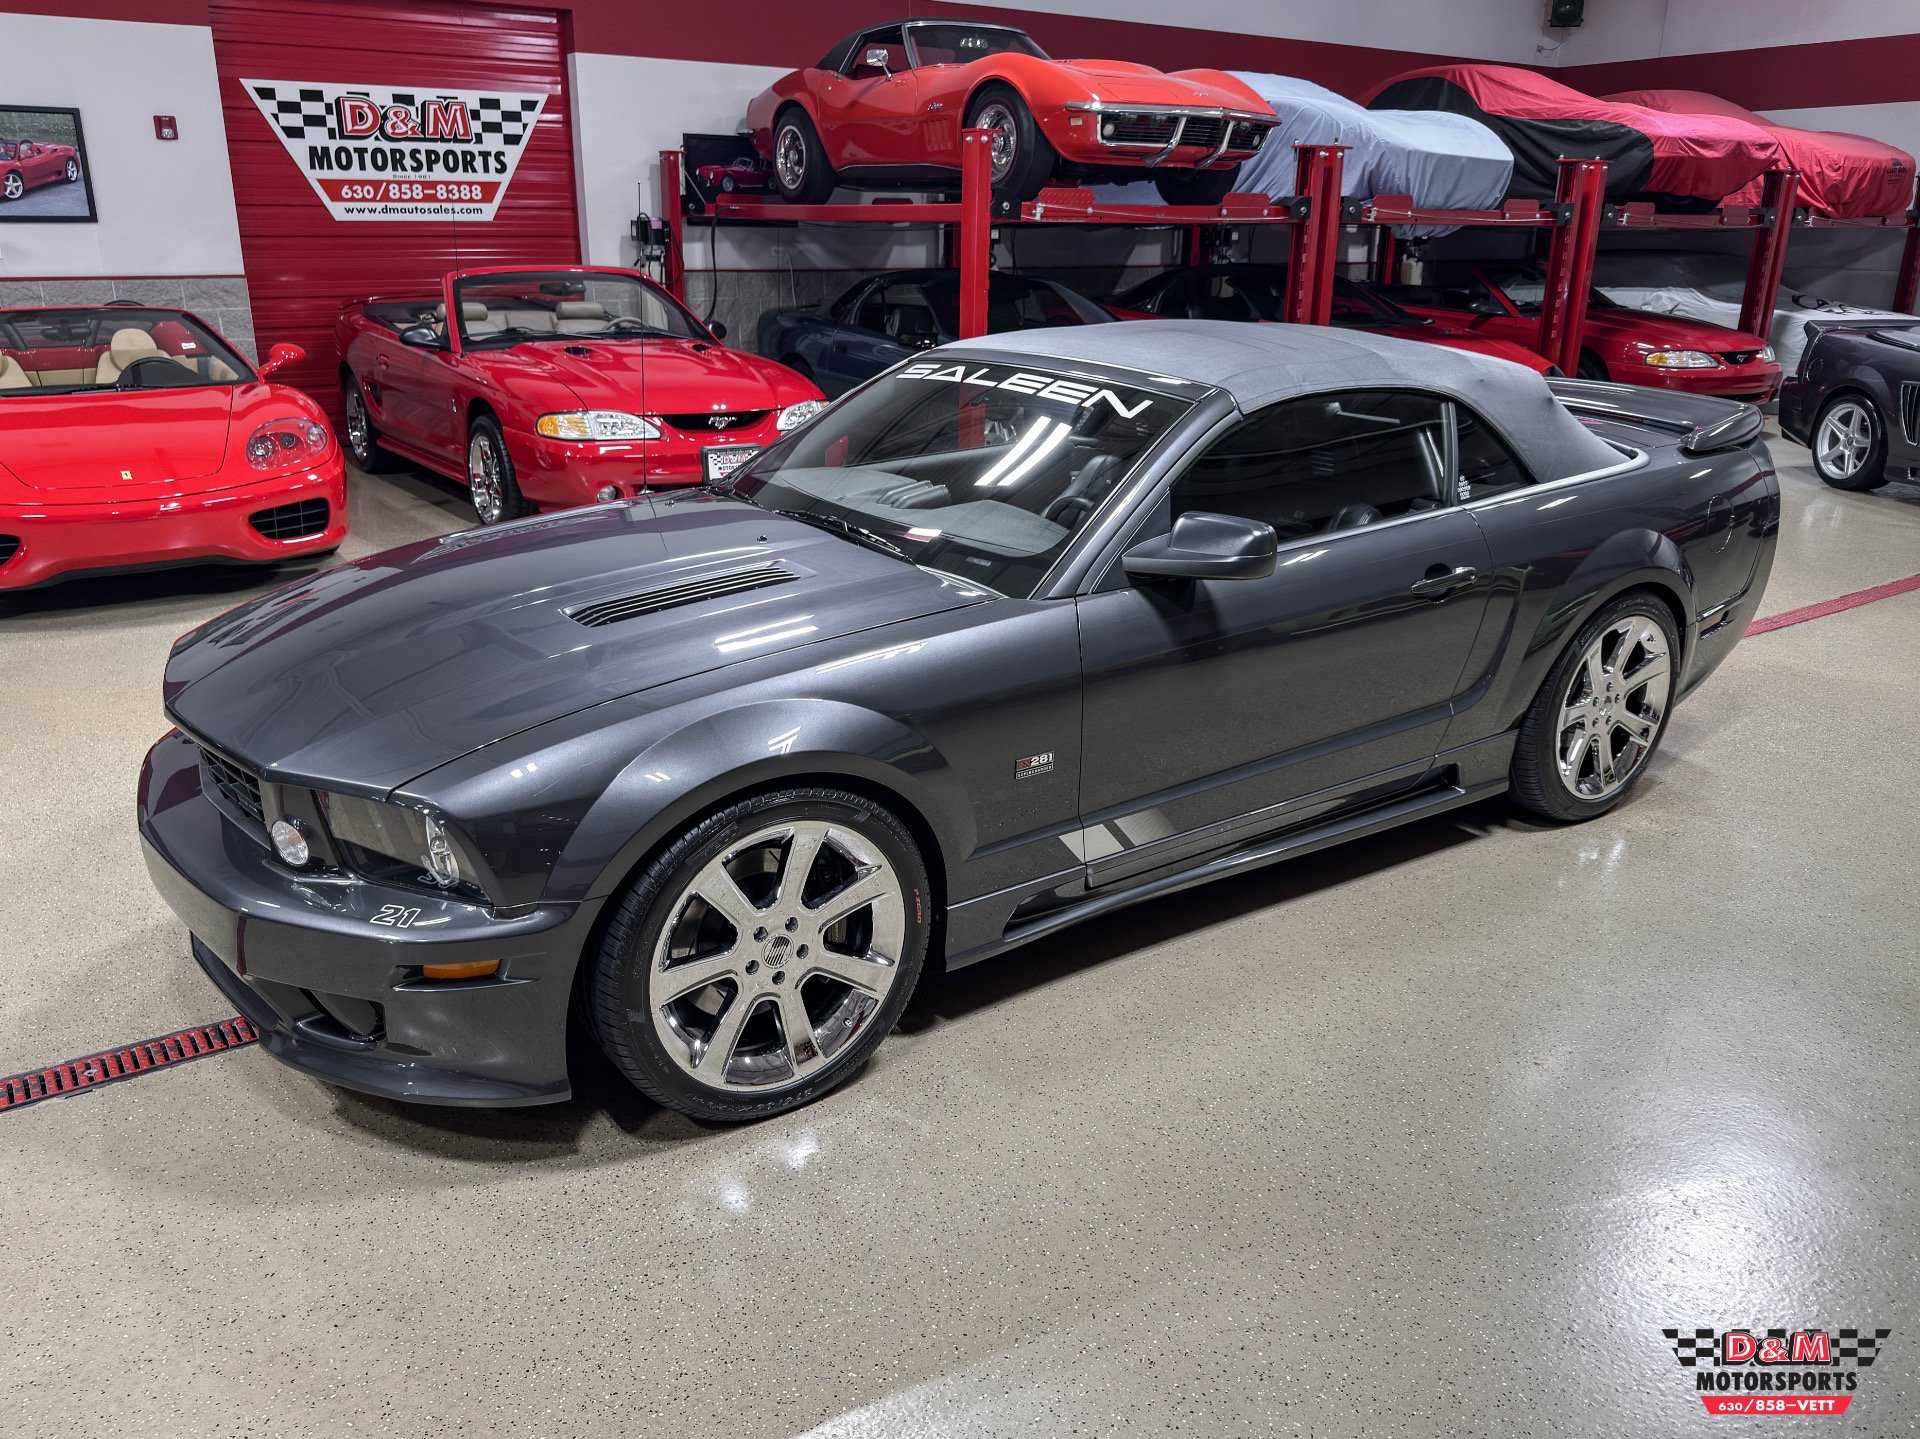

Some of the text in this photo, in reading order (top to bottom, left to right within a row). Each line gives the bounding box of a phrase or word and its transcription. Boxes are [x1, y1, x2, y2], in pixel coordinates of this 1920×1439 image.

[335, 96, 473, 143] D&M
[309, 145, 508, 174] MOTORSPORTS
[344, 204, 483, 215] www.dmautosales.com
[896, 363, 1154, 419] SALEEN
[369, 904, 421, 928] 21
